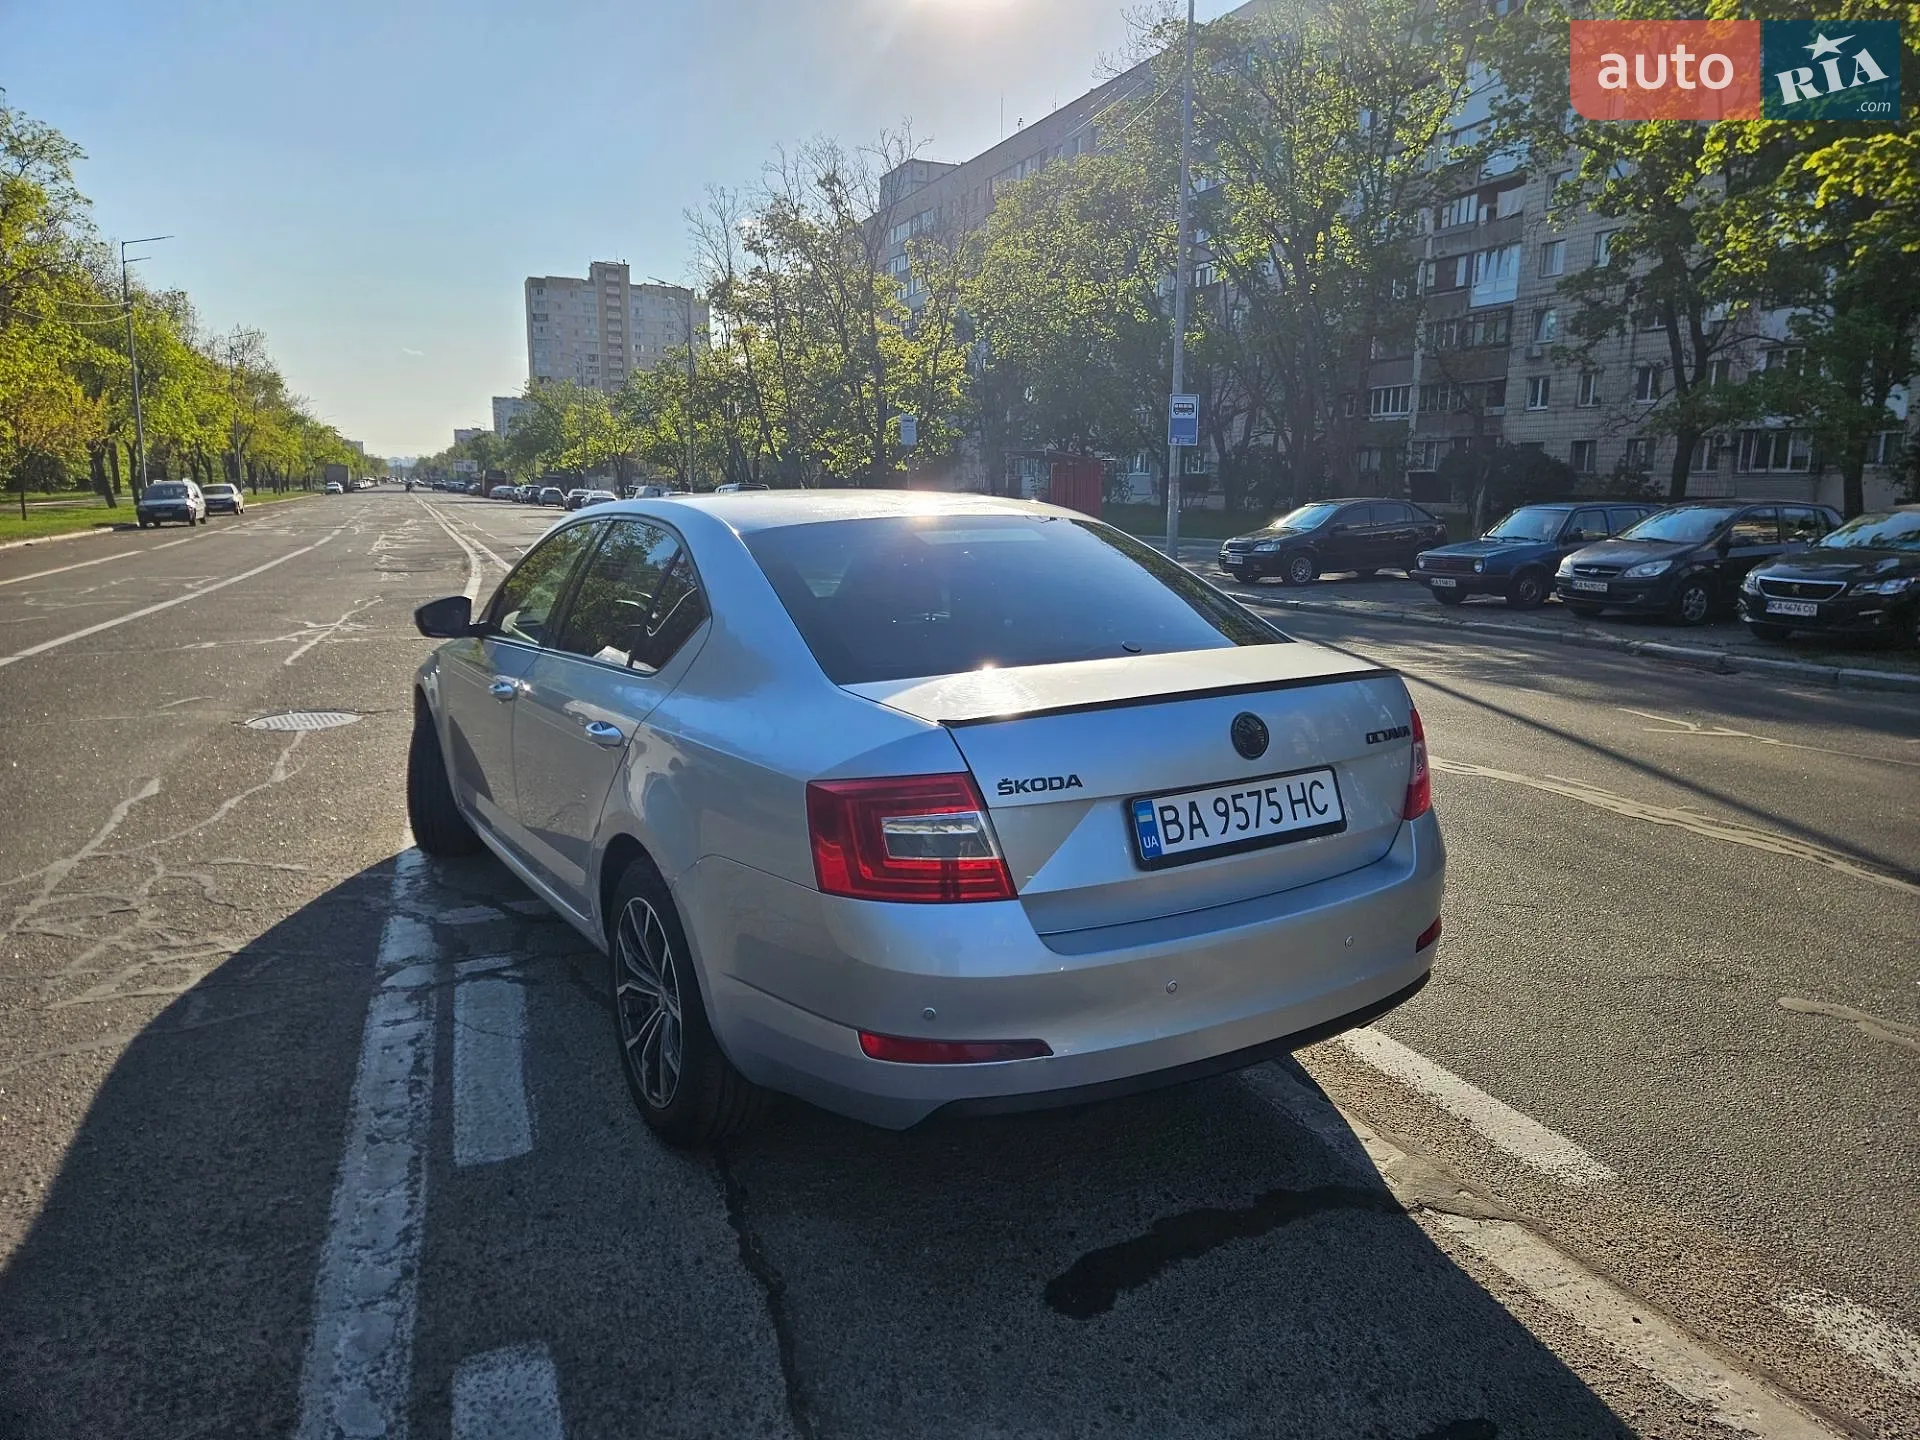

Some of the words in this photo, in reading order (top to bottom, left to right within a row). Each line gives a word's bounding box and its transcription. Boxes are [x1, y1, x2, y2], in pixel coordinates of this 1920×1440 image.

[997, 774, 1083, 796] ŠKODA
[1158, 800, 1210, 845] BA
[1213, 787, 1284, 835] 9575
[1286, 779, 1329, 821] HC
[1143, 835, 1159, 849] UA
